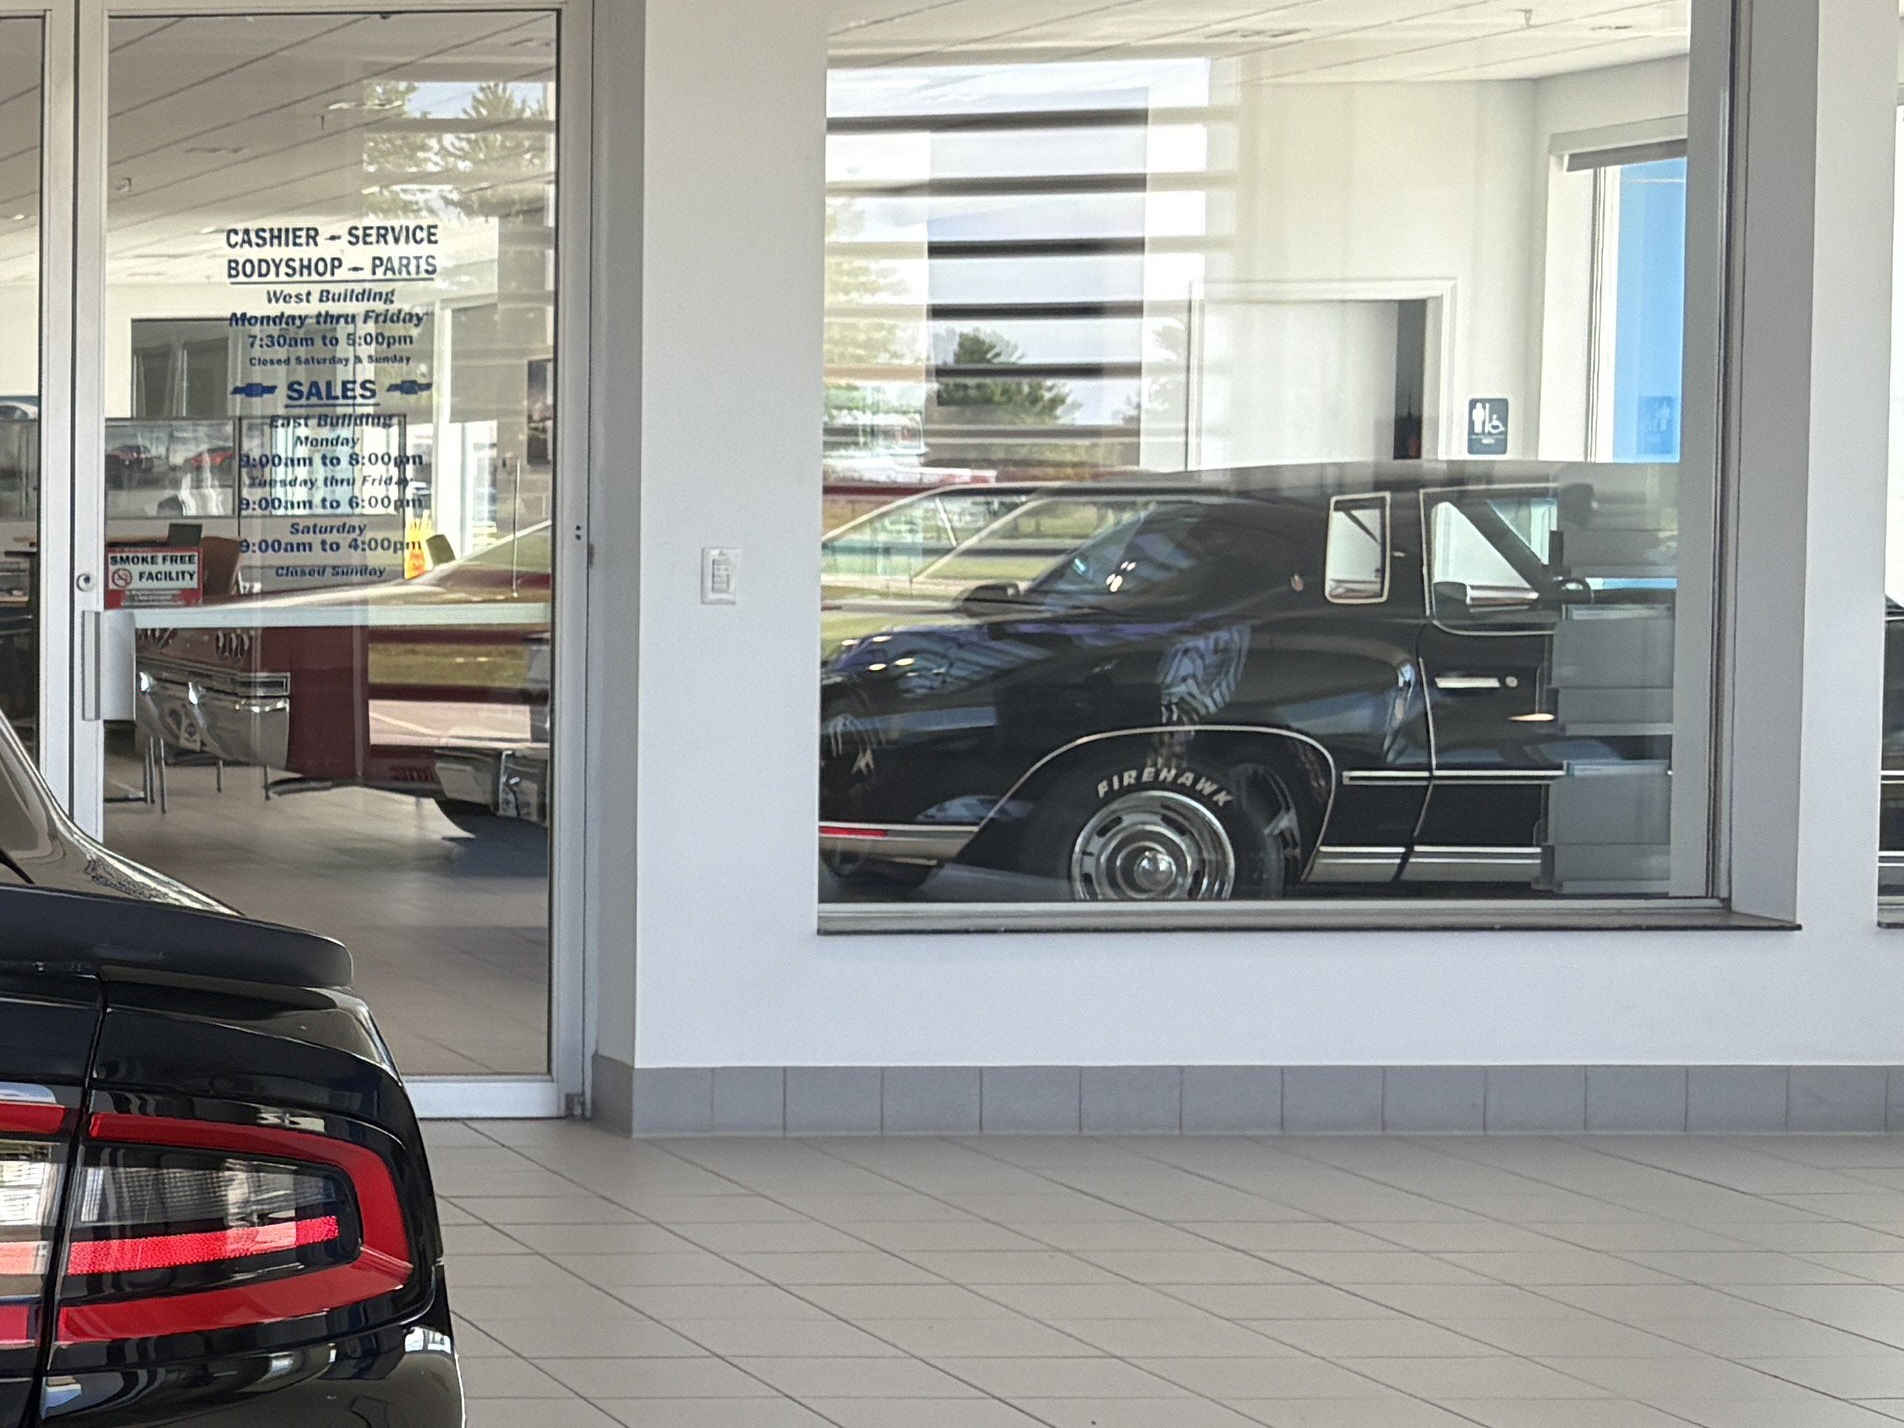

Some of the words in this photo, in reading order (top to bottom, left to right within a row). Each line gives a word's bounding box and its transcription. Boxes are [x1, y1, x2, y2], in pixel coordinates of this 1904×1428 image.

[226, 226, 319, 248] CASHIER
[347, 224, 438, 246] SERVICE
[227, 257, 342, 279] BODYSHOP
[371, 255, 437, 276] PARTS
[267, 289, 311, 304] West
[318, 288, 395, 305] Building
[229, 311, 307, 328] Monday
[315, 310, 356, 326] thru
[363, 309, 427, 327] Friday
[248, 334, 314, 348] 7:30am
[321, 335, 339, 347] to
[347, 332, 414, 349] 5:00pm
[249, 356, 290, 367] Closed
[295, 355, 350, 367] Saturday
[367, 354, 411, 367] Sunday
[286, 380, 377, 401] SALES
[270, 414, 311, 429] East
[317, 413, 396, 429] Building
[294, 435, 359, 449] Monday
[321, 455, 341, 467] to
[248, 476, 317, 490] Tuesday
[323, 475, 355, 487] thru
[239, 497, 313, 511] 9:00am
[321, 497, 341, 509] to
[290, 522, 367, 536] Saturday
[239, 539, 313, 553] 9:00am
[321, 539, 340, 552] to
[348, 538, 422, 554] 4:00pm
[110, 554, 159, 566] SMOKE
[162, 554, 196, 565] FREE
[139, 570, 196, 582] FACILITY
[275, 566, 326, 577] Closed
[331, 565, 386, 578] Sunday
[1097, 766, 1235, 808] FIREHAWK
